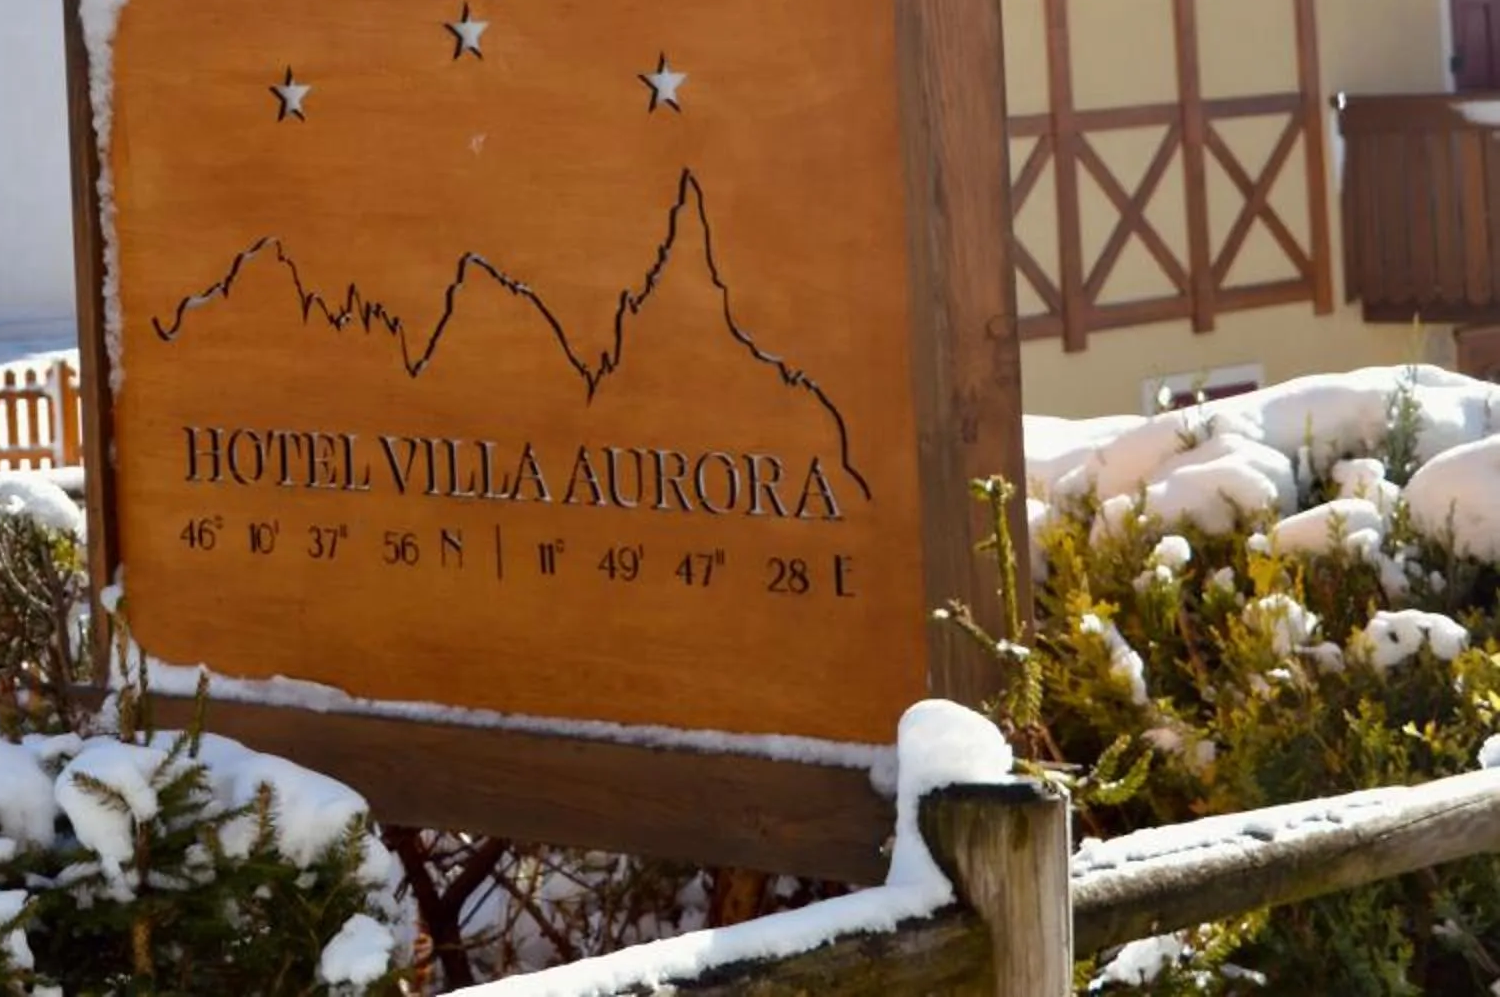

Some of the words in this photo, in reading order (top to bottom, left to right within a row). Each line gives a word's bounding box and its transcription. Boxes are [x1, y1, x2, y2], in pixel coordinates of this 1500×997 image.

[183, 426, 371, 490] HOTEL
[378, 435, 552, 502] VILLA
[562, 444, 844, 519] AURORA
[382, 529, 420, 566] 56
[440, 527, 463, 570] N
[767, 556, 810, 595] 28
[833, 554, 856, 598] E
